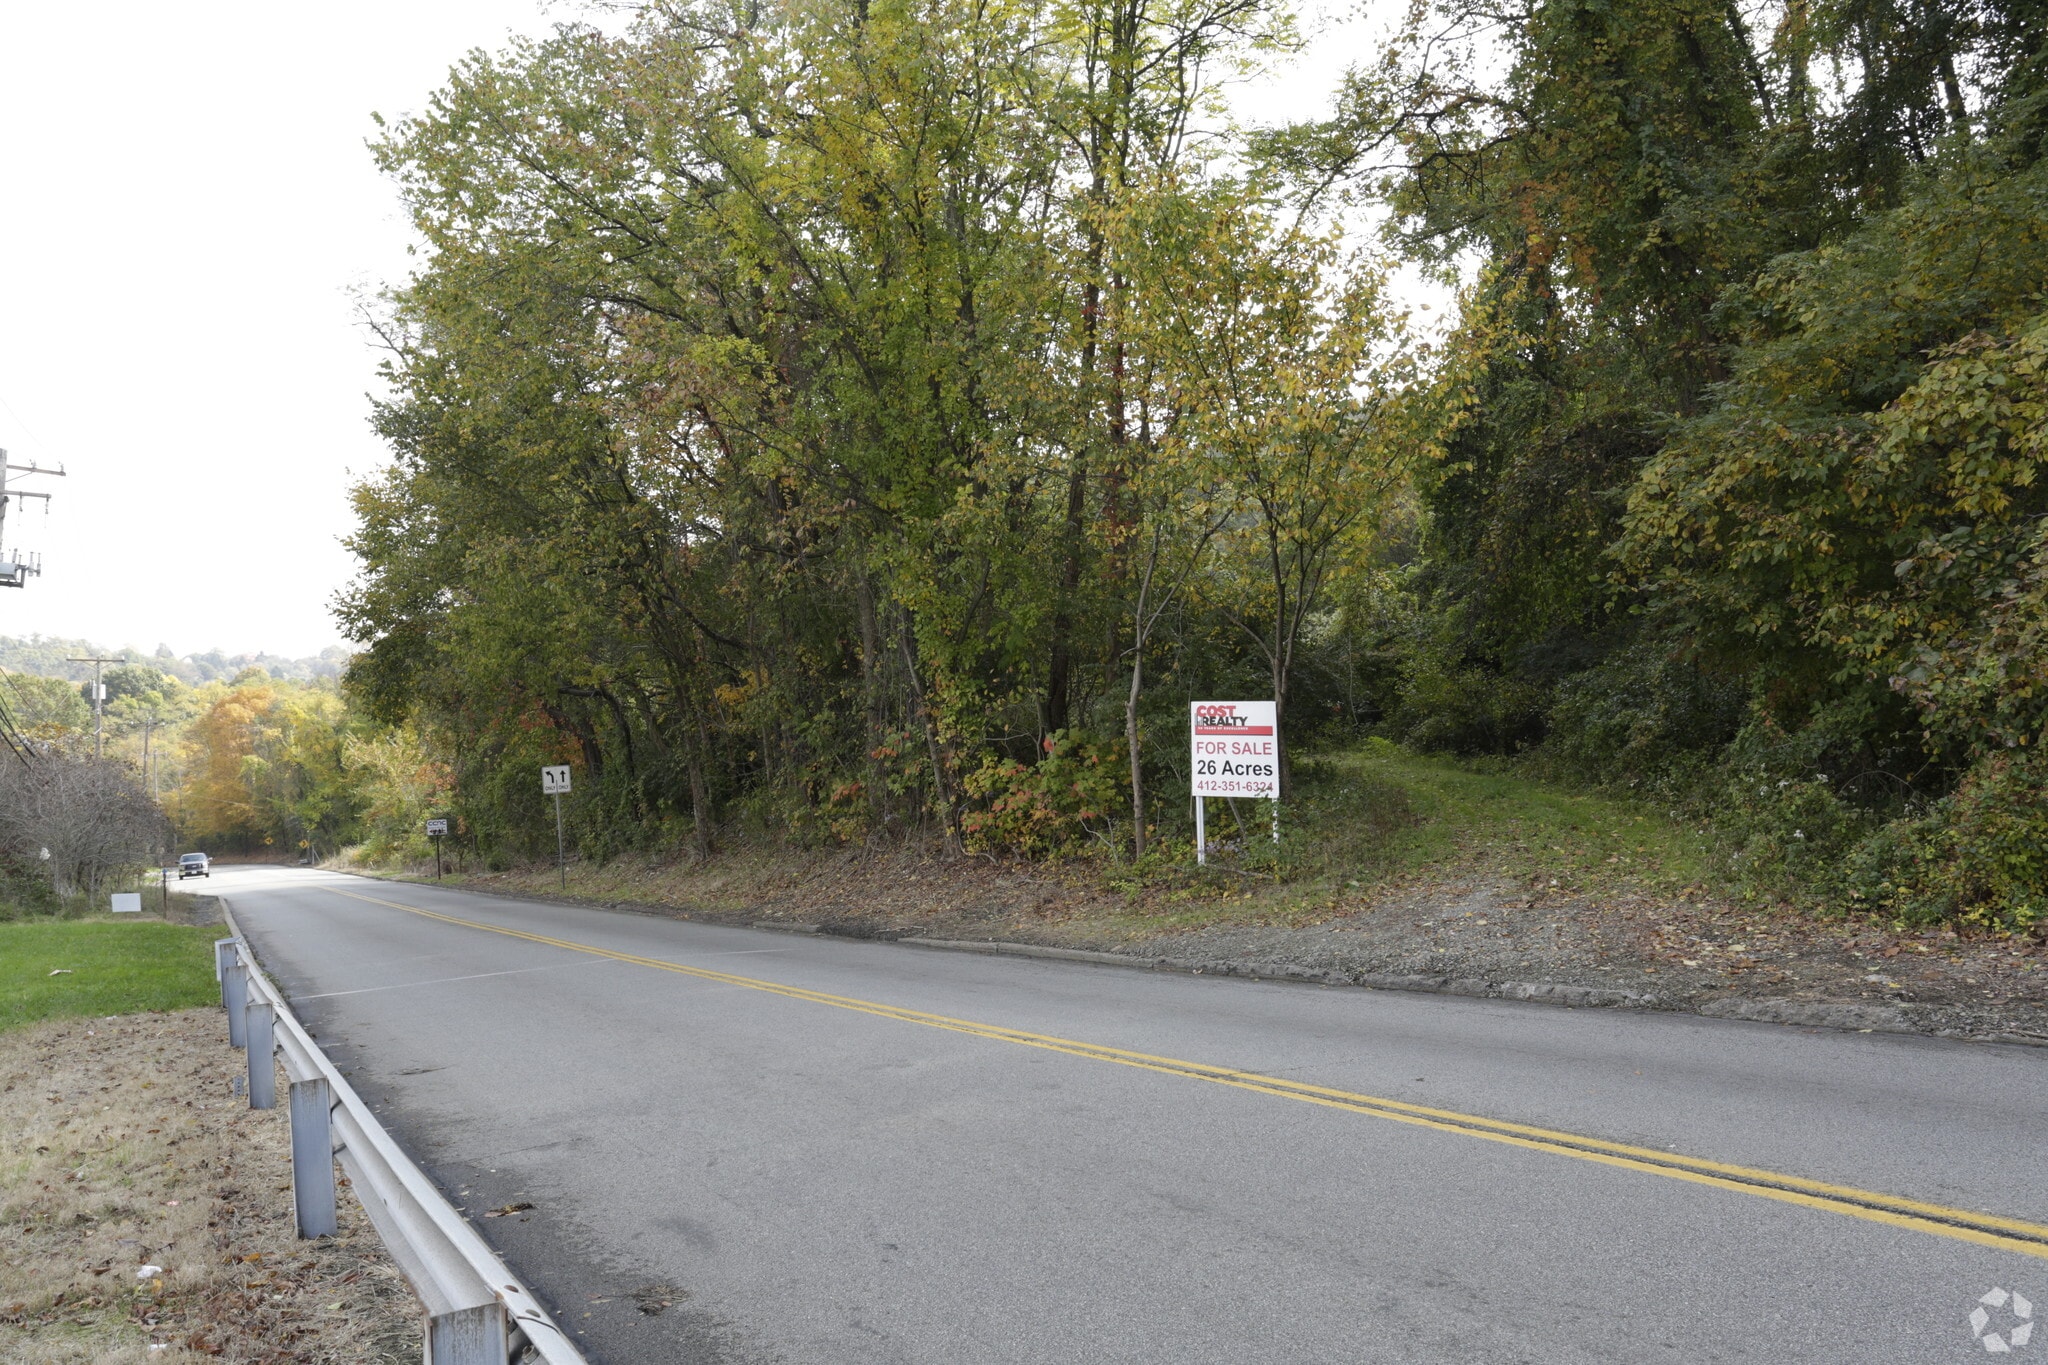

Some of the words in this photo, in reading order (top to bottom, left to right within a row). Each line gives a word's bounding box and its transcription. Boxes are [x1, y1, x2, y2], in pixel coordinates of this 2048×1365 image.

[1196, 705, 1236, 717] COST
[1203, 716, 1247, 726] REALTY
[1196, 742, 1227, 754] FOR
[1231, 742, 1272, 755] SALE
[1197, 760, 1216, 775] 26
[1221, 760, 1273, 776] Acres
[1197, 780, 1273, 792] 412-351-6324
